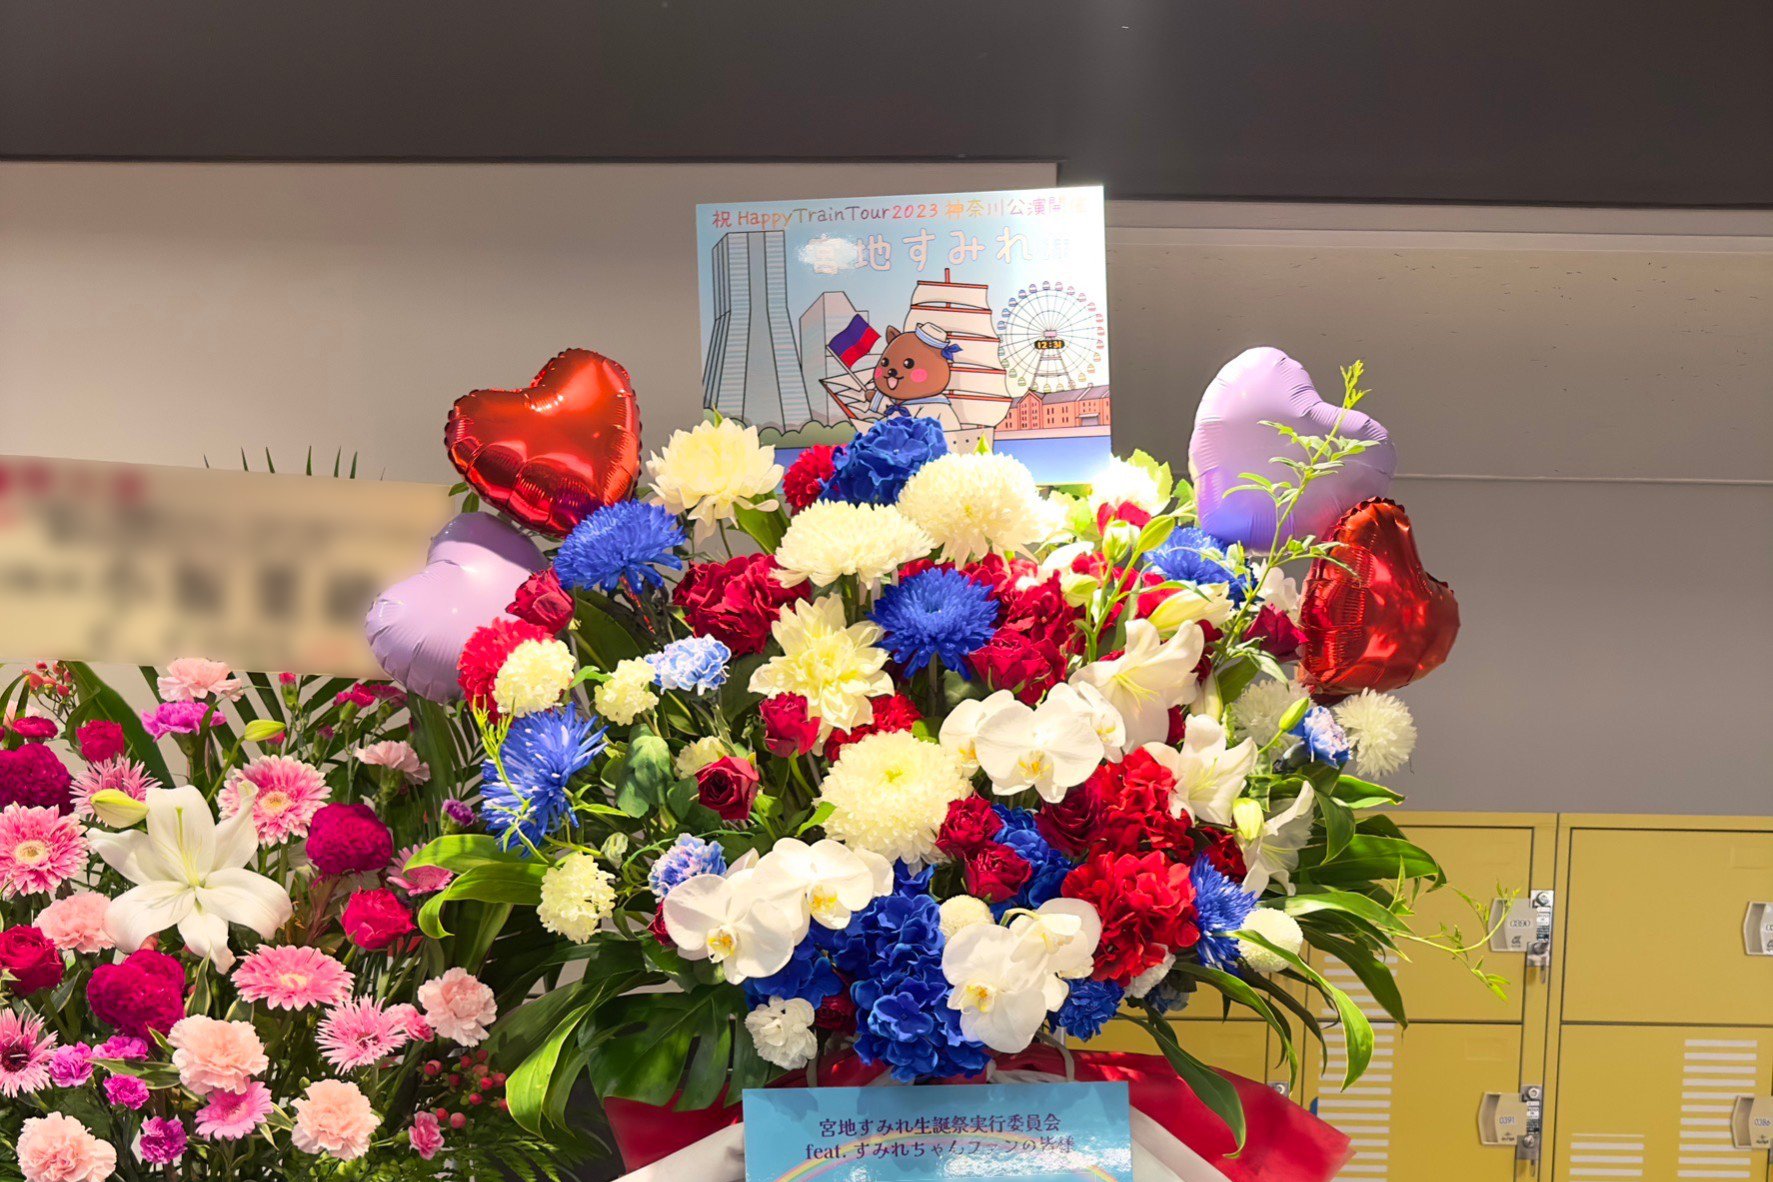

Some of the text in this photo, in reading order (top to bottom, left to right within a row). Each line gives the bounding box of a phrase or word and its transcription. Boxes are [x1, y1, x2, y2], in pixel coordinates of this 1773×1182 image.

[712, 210, 732, 228] 祝
[819, 1112, 1060, 1137] 宮地すみれ生誕祭実行委員会
[806, 1143, 846, 1160] feat.
